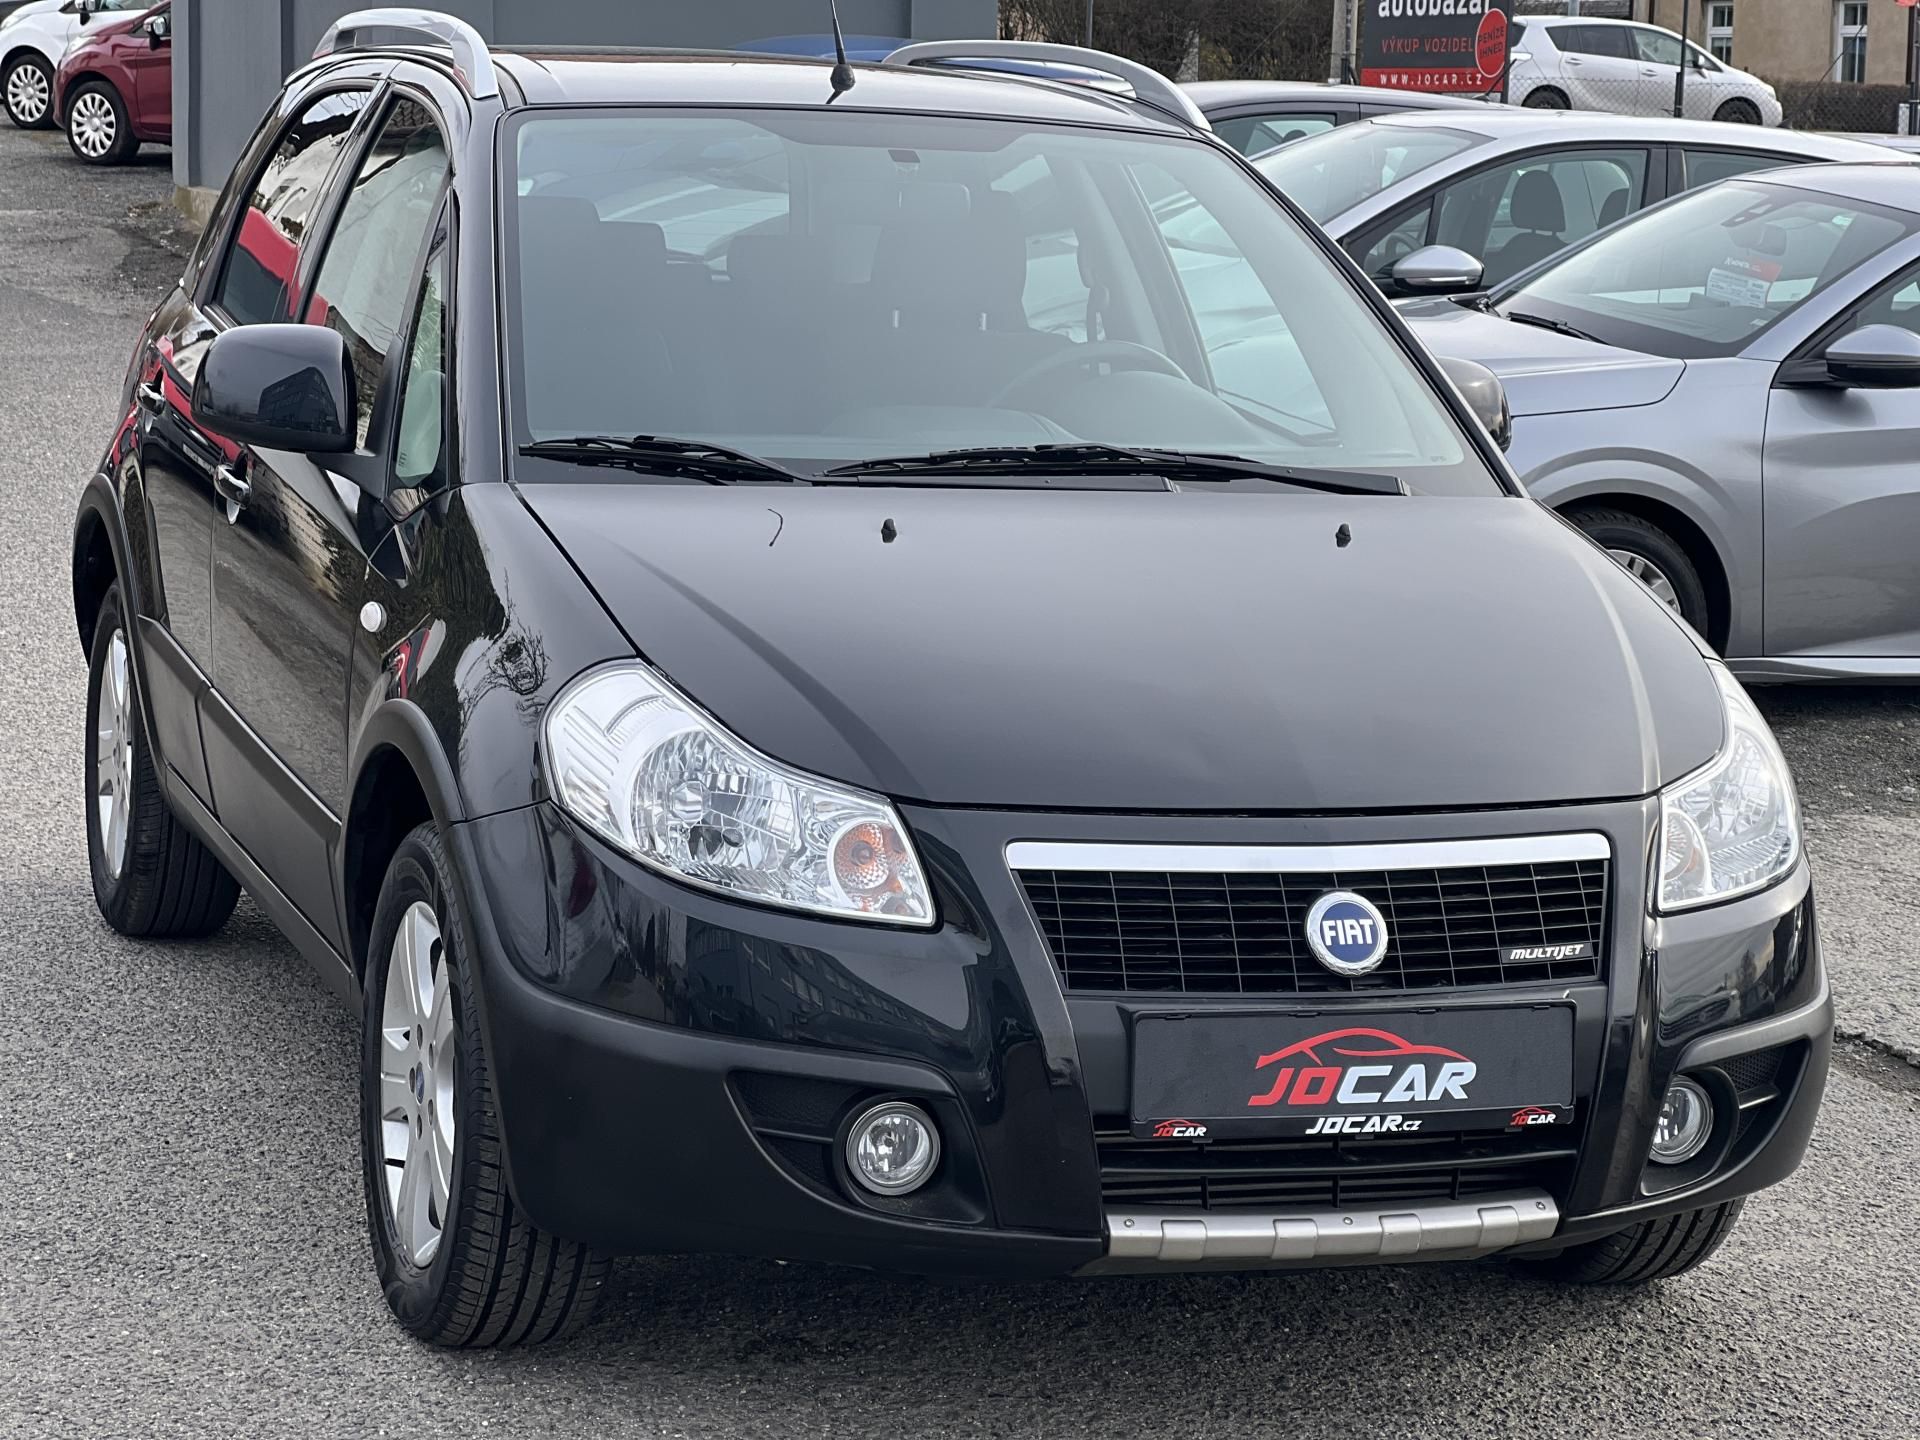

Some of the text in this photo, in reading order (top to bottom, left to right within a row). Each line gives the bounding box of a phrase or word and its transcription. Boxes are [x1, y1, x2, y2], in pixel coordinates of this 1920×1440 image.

[1381, 35, 1474, 54] VÝKUP VOZIDEL
[1379, 73, 1483, 86] WWW.JOCAR.CZ
[1322, 918, 1376, 946] FIAT
[1509, 943, 1585, 961] MULTIJET
[1247, 1061, 1477, 1107] JOCAR
[1509, 1113, 1556, 1126] JOCAR
[1152, 1125, 1207, 1137] JOCAR
